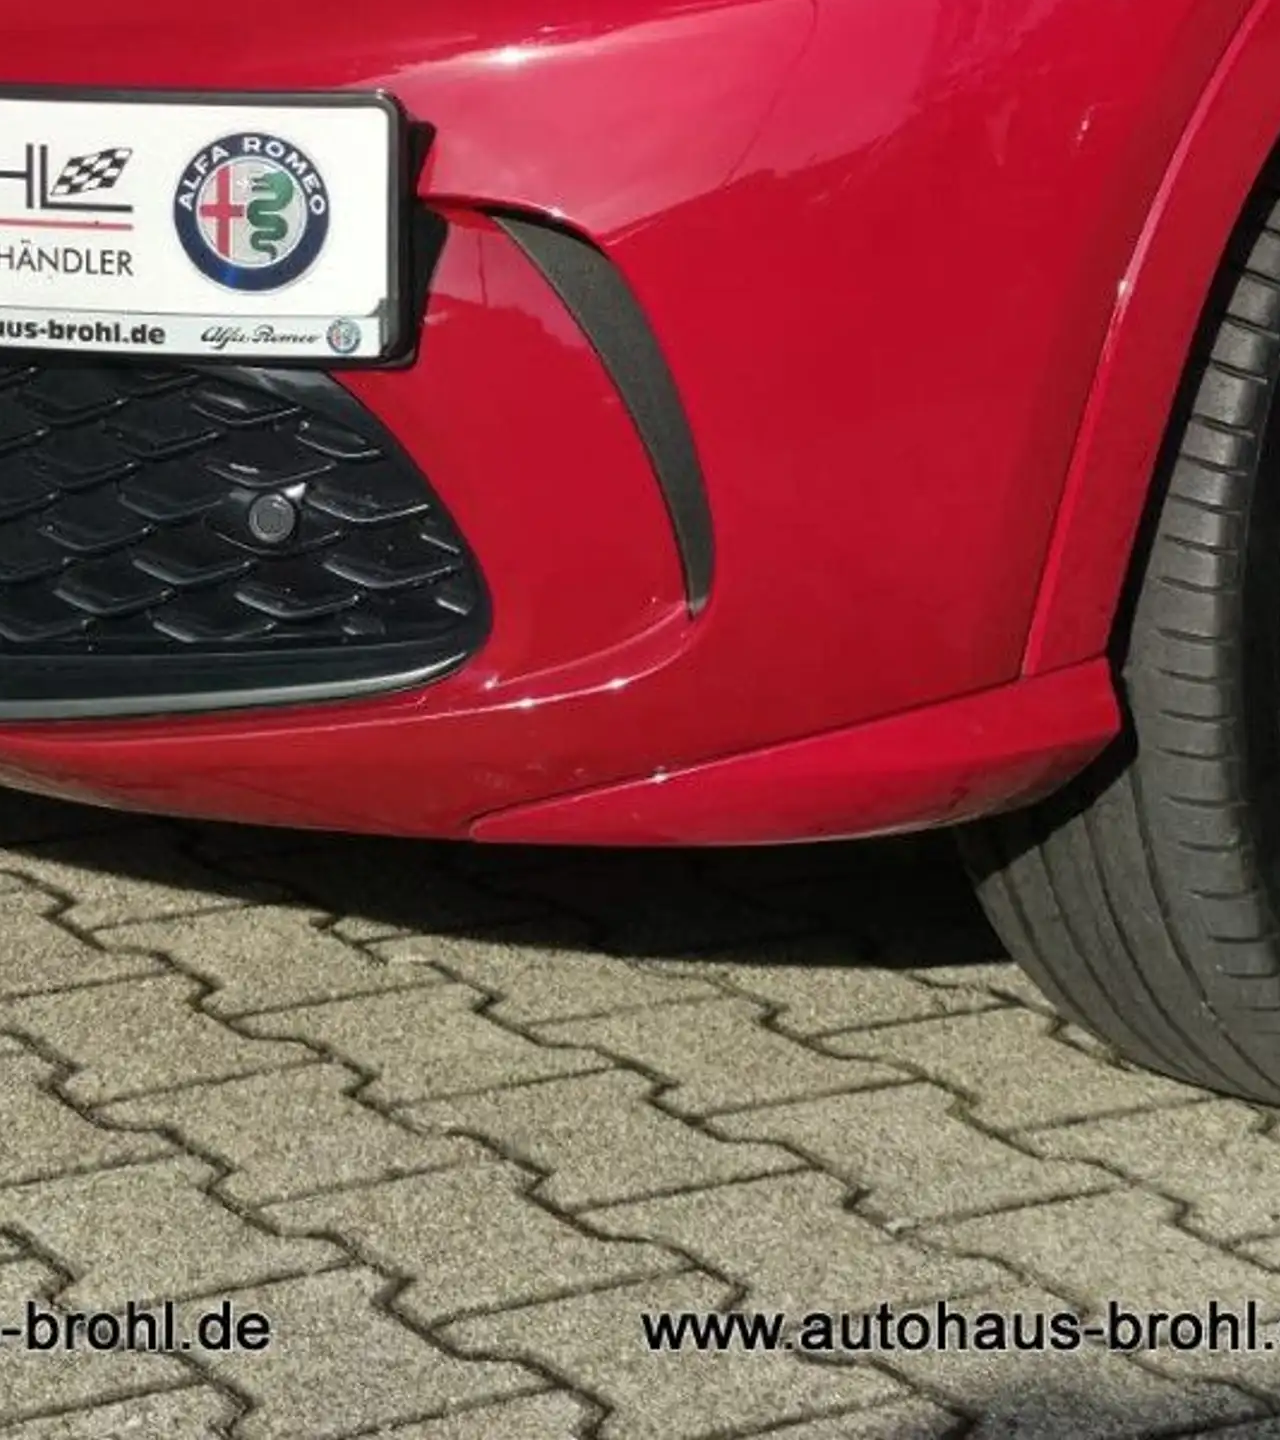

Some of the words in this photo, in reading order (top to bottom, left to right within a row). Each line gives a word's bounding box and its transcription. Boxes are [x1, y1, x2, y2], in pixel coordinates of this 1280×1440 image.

[178, 145, 230, 211] ALFA
[242, 136, 326, 215] ROMEO
[200, 325, 247, 350] Alfa
